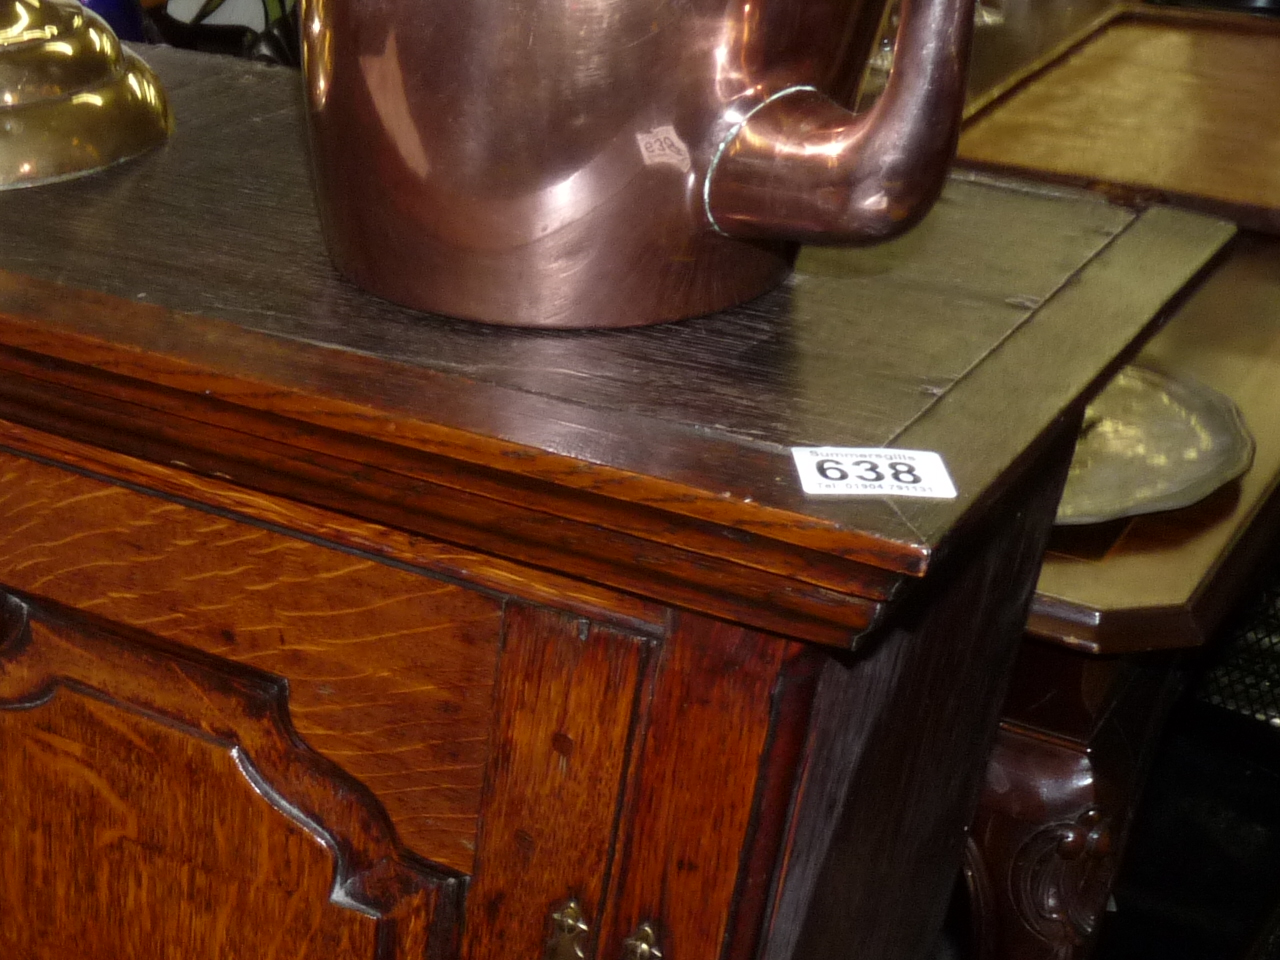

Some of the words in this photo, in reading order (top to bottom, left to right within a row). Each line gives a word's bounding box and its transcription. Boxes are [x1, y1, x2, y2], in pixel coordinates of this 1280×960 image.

[809, 450, 916, 461] Summersgills
[816, 459, 922, 484] 638
[846, 483, 884, 491] 01904
[890, 484, 934, 493] 791131
